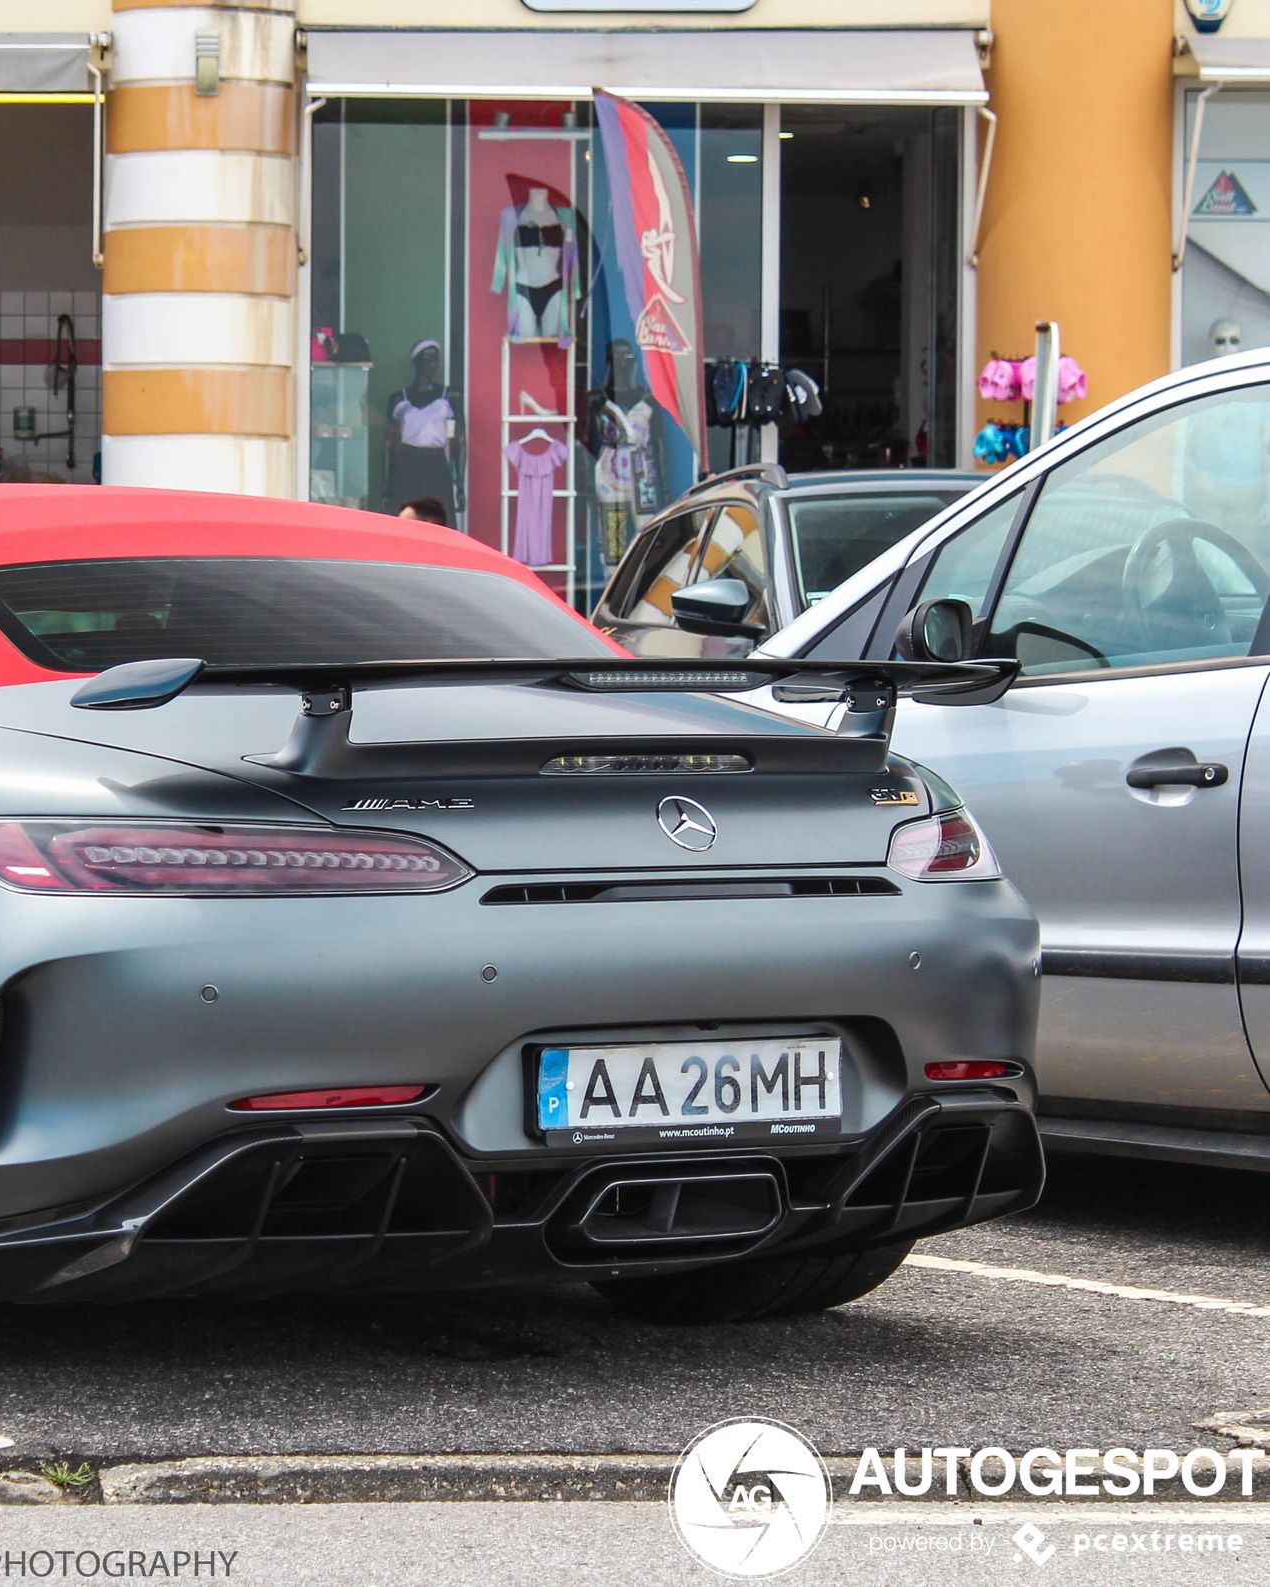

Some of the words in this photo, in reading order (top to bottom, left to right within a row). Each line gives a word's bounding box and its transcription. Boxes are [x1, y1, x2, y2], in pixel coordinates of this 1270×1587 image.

[548, 1097, 559, 1113] P
[583, 1133, 615, 1141] Mercedes-Benz
[659, 1126, 735, 1138] www.mcoutinho.pt
